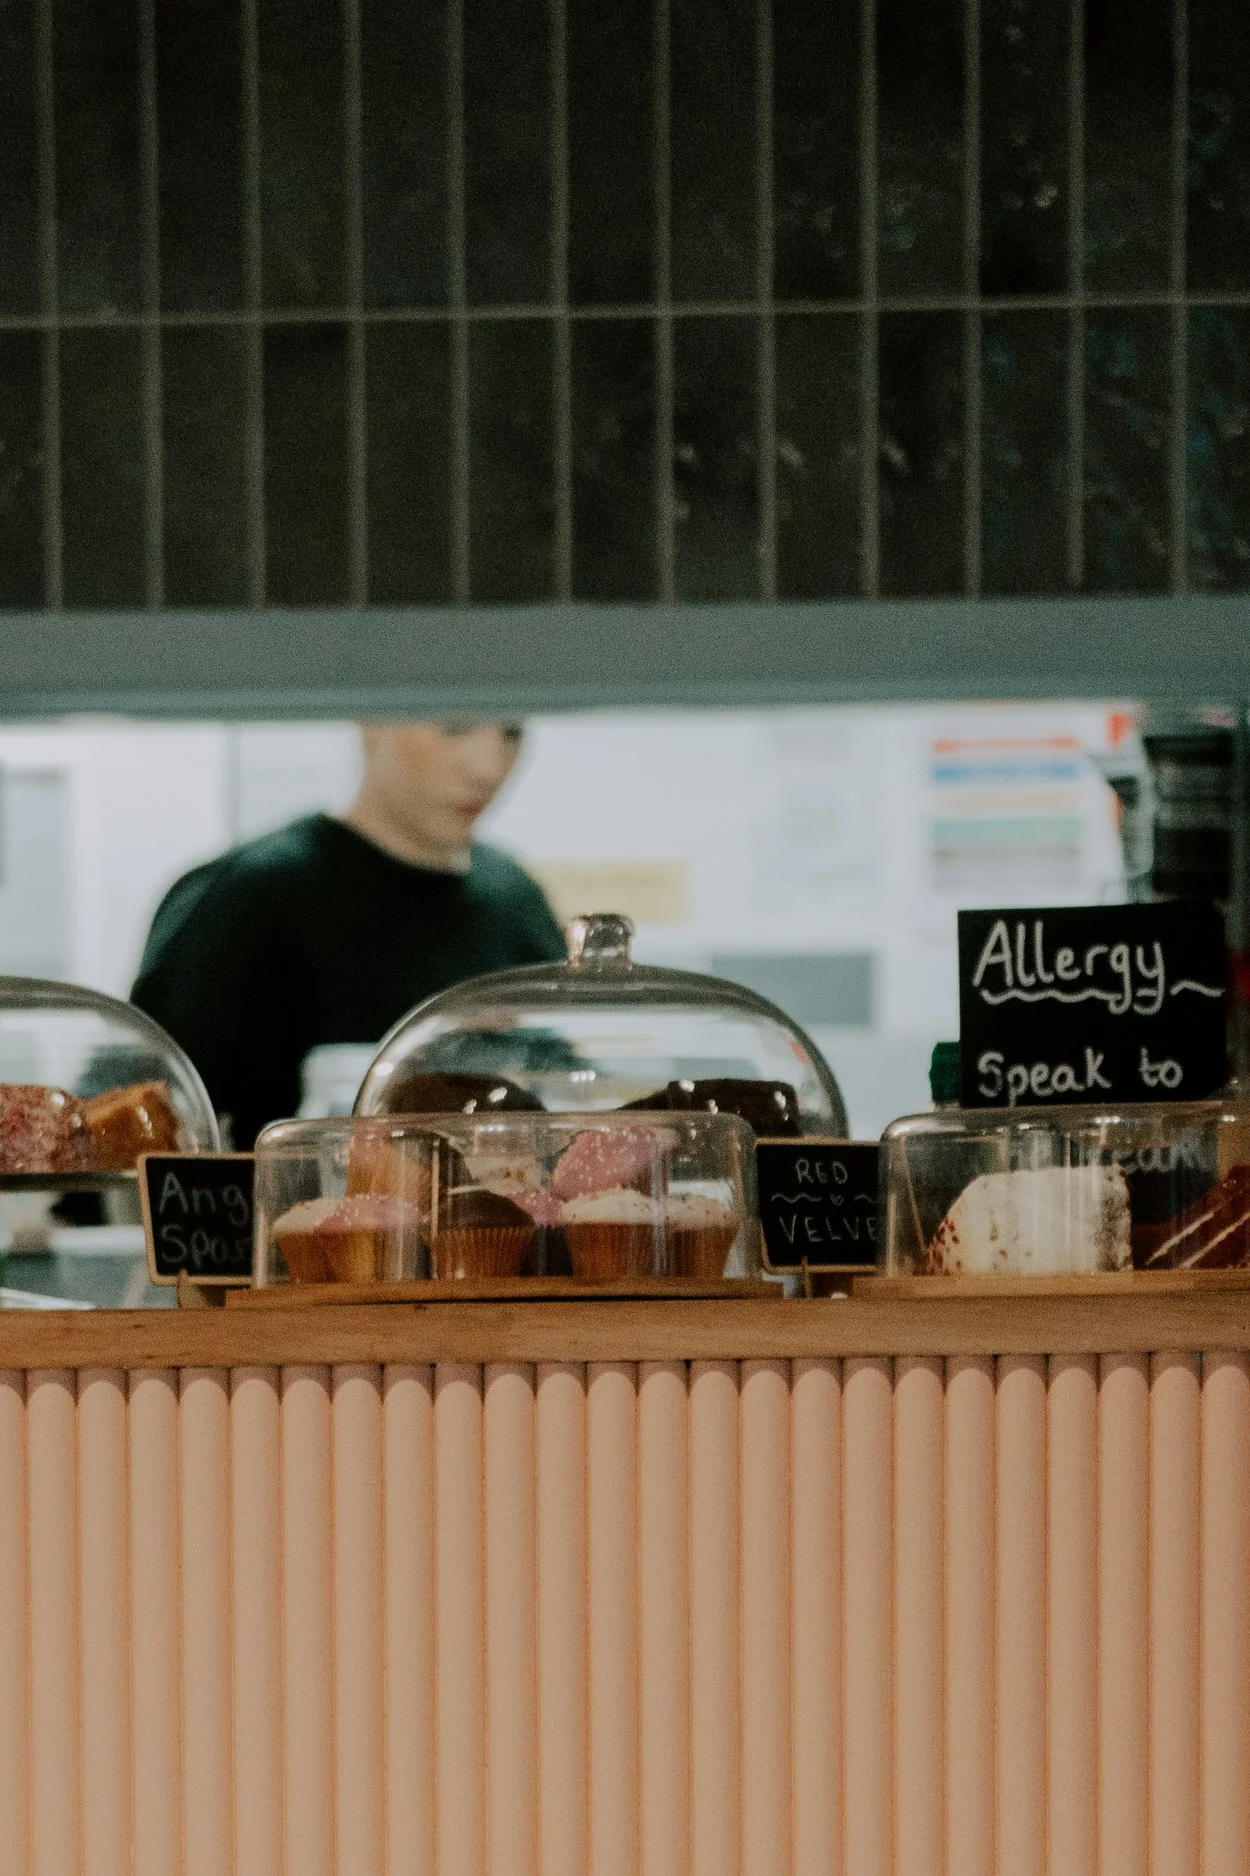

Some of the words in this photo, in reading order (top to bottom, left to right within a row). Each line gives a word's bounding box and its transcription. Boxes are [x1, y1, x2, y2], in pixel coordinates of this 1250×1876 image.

[972, 919, 1166, 1015] Allergy
[977, 1046, 1112, 1107] Speak
[1139, 1047, 1183, 1088] to
[794, 1158, 849, 1184] RED
